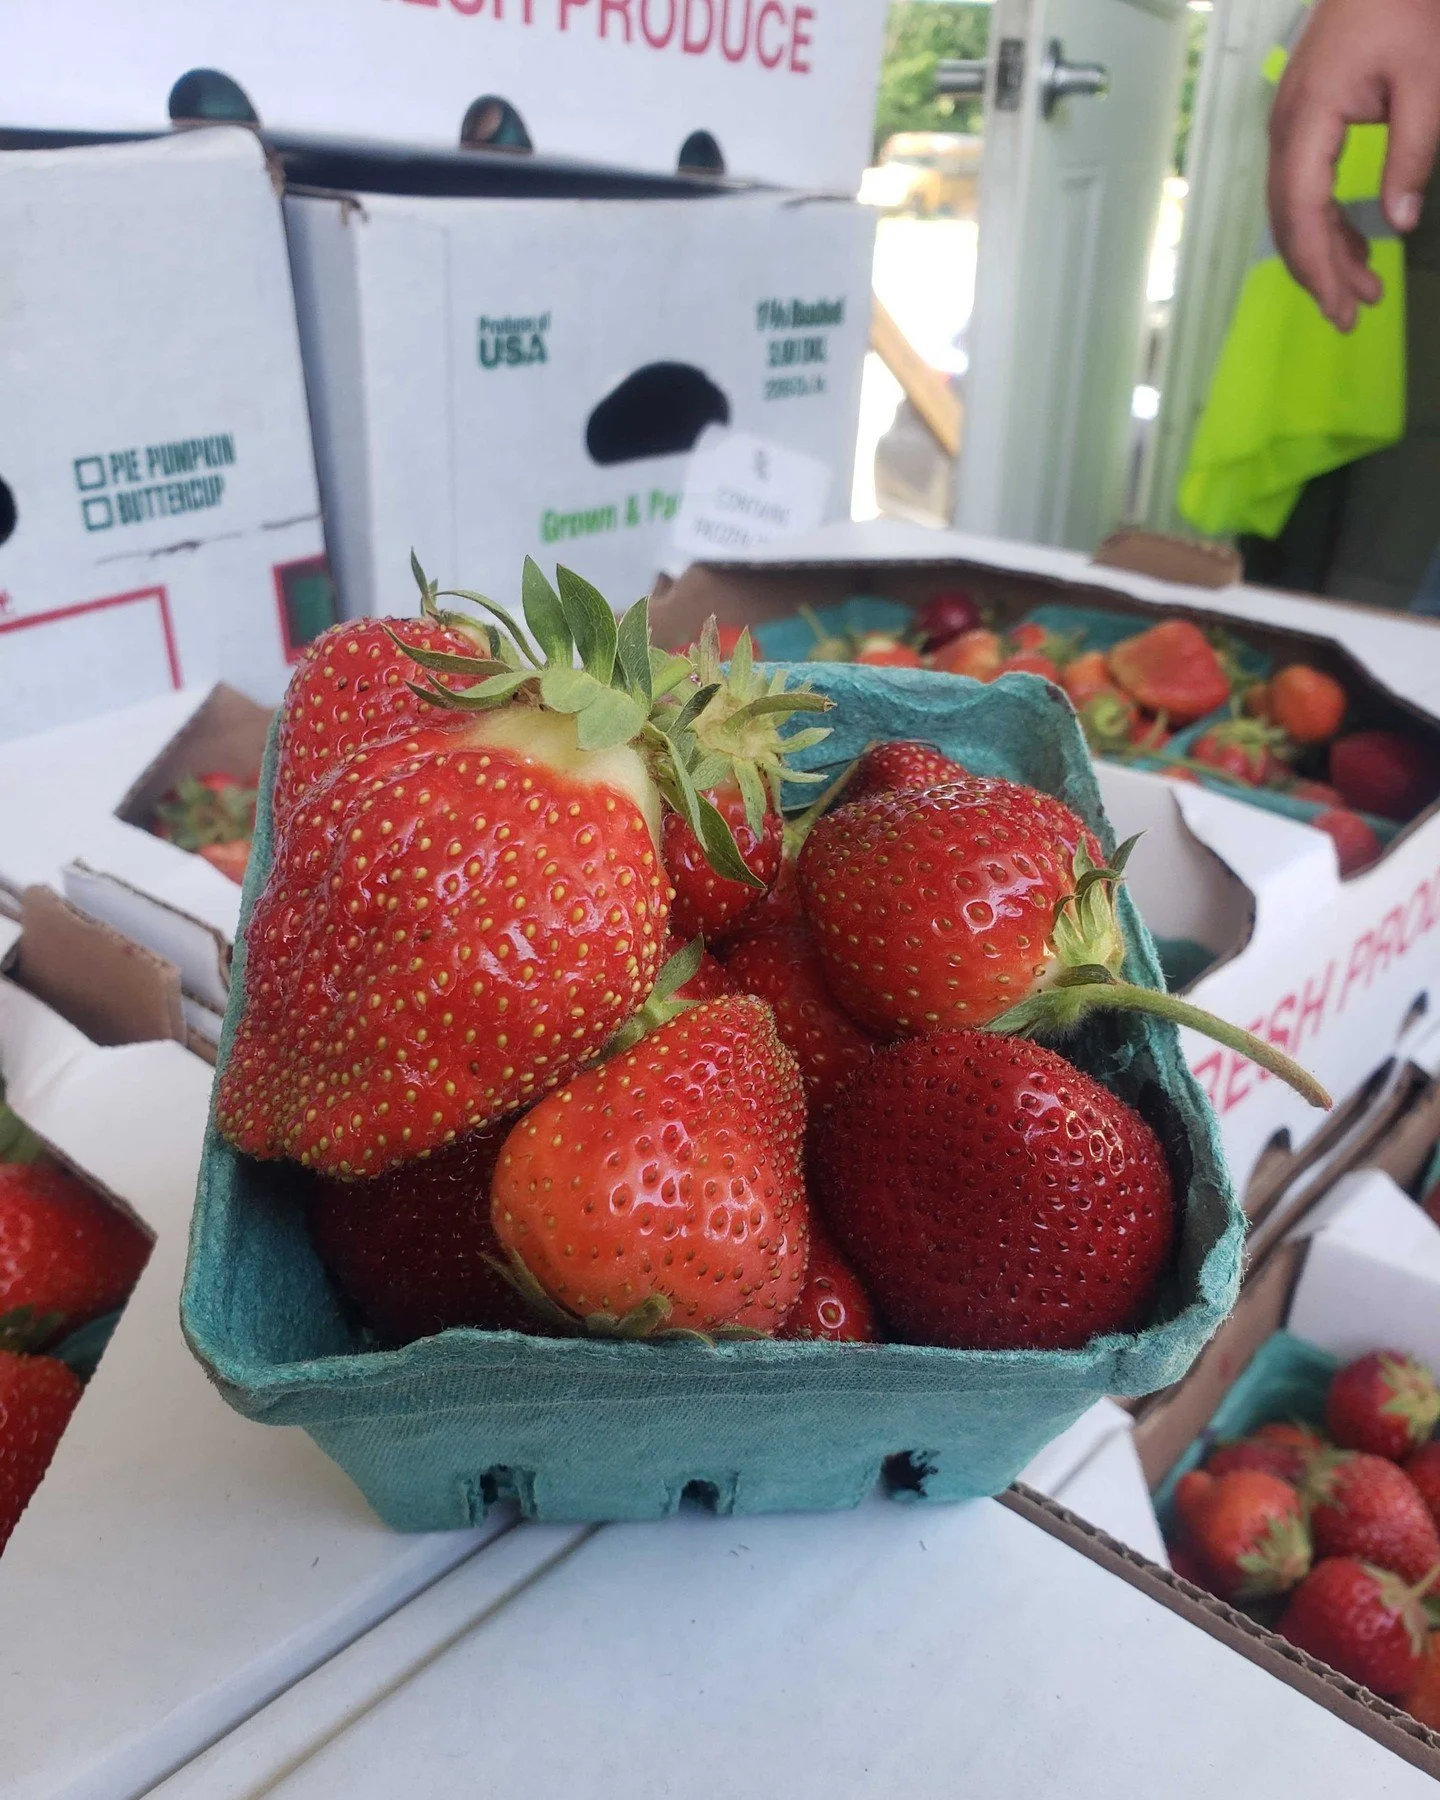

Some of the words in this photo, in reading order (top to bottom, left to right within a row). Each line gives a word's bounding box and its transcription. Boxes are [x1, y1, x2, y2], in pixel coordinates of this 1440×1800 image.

[479, 334, 548, 370] USA
[108, 449, 141, 484] PIE
[146, 432, 236, 478] PUMPKIN
[116, 475, 225, 525] BUTTERCUP
[541, 505, 618, 544] Grown
[649, 488, 684, 522] Pa
[1336, 862, 1440, 1014] PRO
